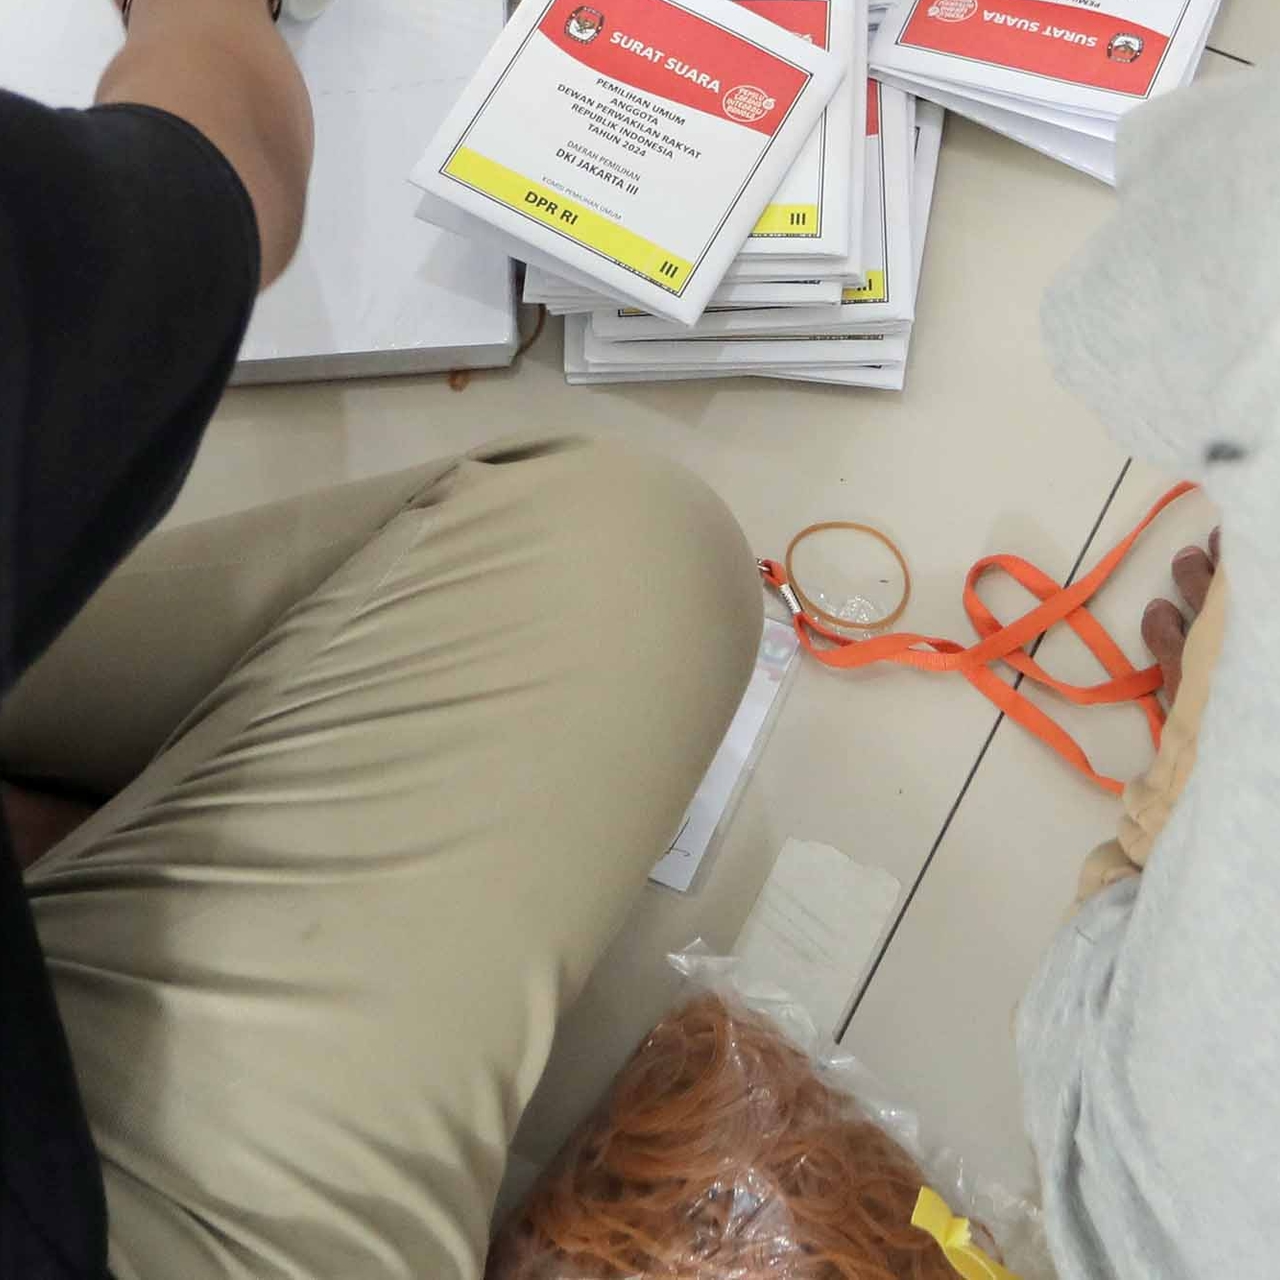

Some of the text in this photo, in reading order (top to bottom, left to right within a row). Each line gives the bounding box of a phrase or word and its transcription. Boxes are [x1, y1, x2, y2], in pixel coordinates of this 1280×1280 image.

[982, 9, 1099, 48] SURAT SUARA
[609, 31, 721, 94] SURAT SUARA
[556, 82, 702, 160] DEWAN PERWAKILAN RAKYAT
[595, 77, 686, 127] PEMILIHAN UMUM
[609, 97, 659, 125] ANGGOTA
[570, 102, 674, 160] REPUBLIK INDONESIA
[587, 123, 647, 158] TAHUN 2024
[555, 147, 640, 196] DKI JAKARTA III
[566, 139, 641, 182] DAERAH PEMILIHAN
[524, 190, 579, 226] DPR RI
[790, 213, 806, 226] III
[659, 260, 679, 279] III
